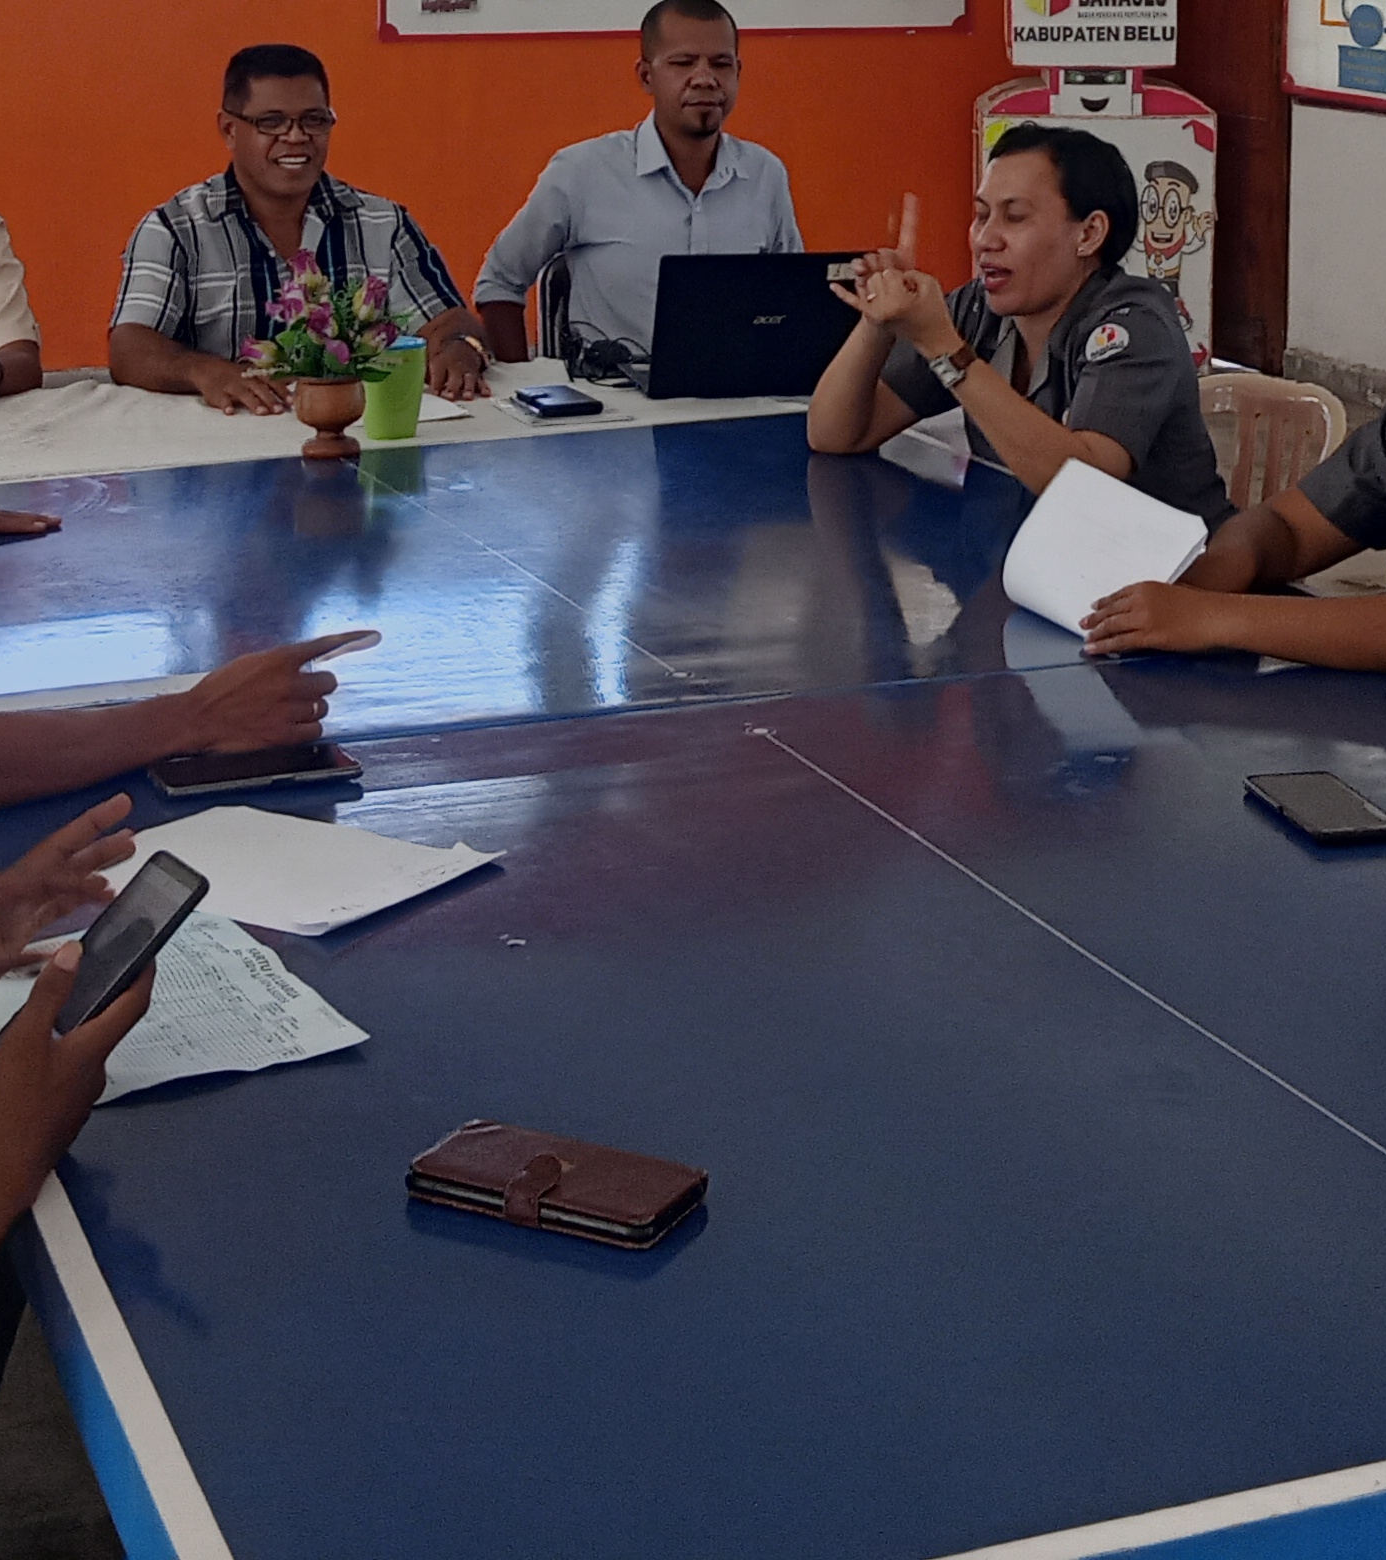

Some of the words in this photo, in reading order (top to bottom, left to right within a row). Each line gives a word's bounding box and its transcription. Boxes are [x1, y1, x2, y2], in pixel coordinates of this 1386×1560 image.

[1014, 26, 1120, 42] KABUPATEN
[1124, 26, 1175, 41] BELU
[753, 315, 787, 325] acer
